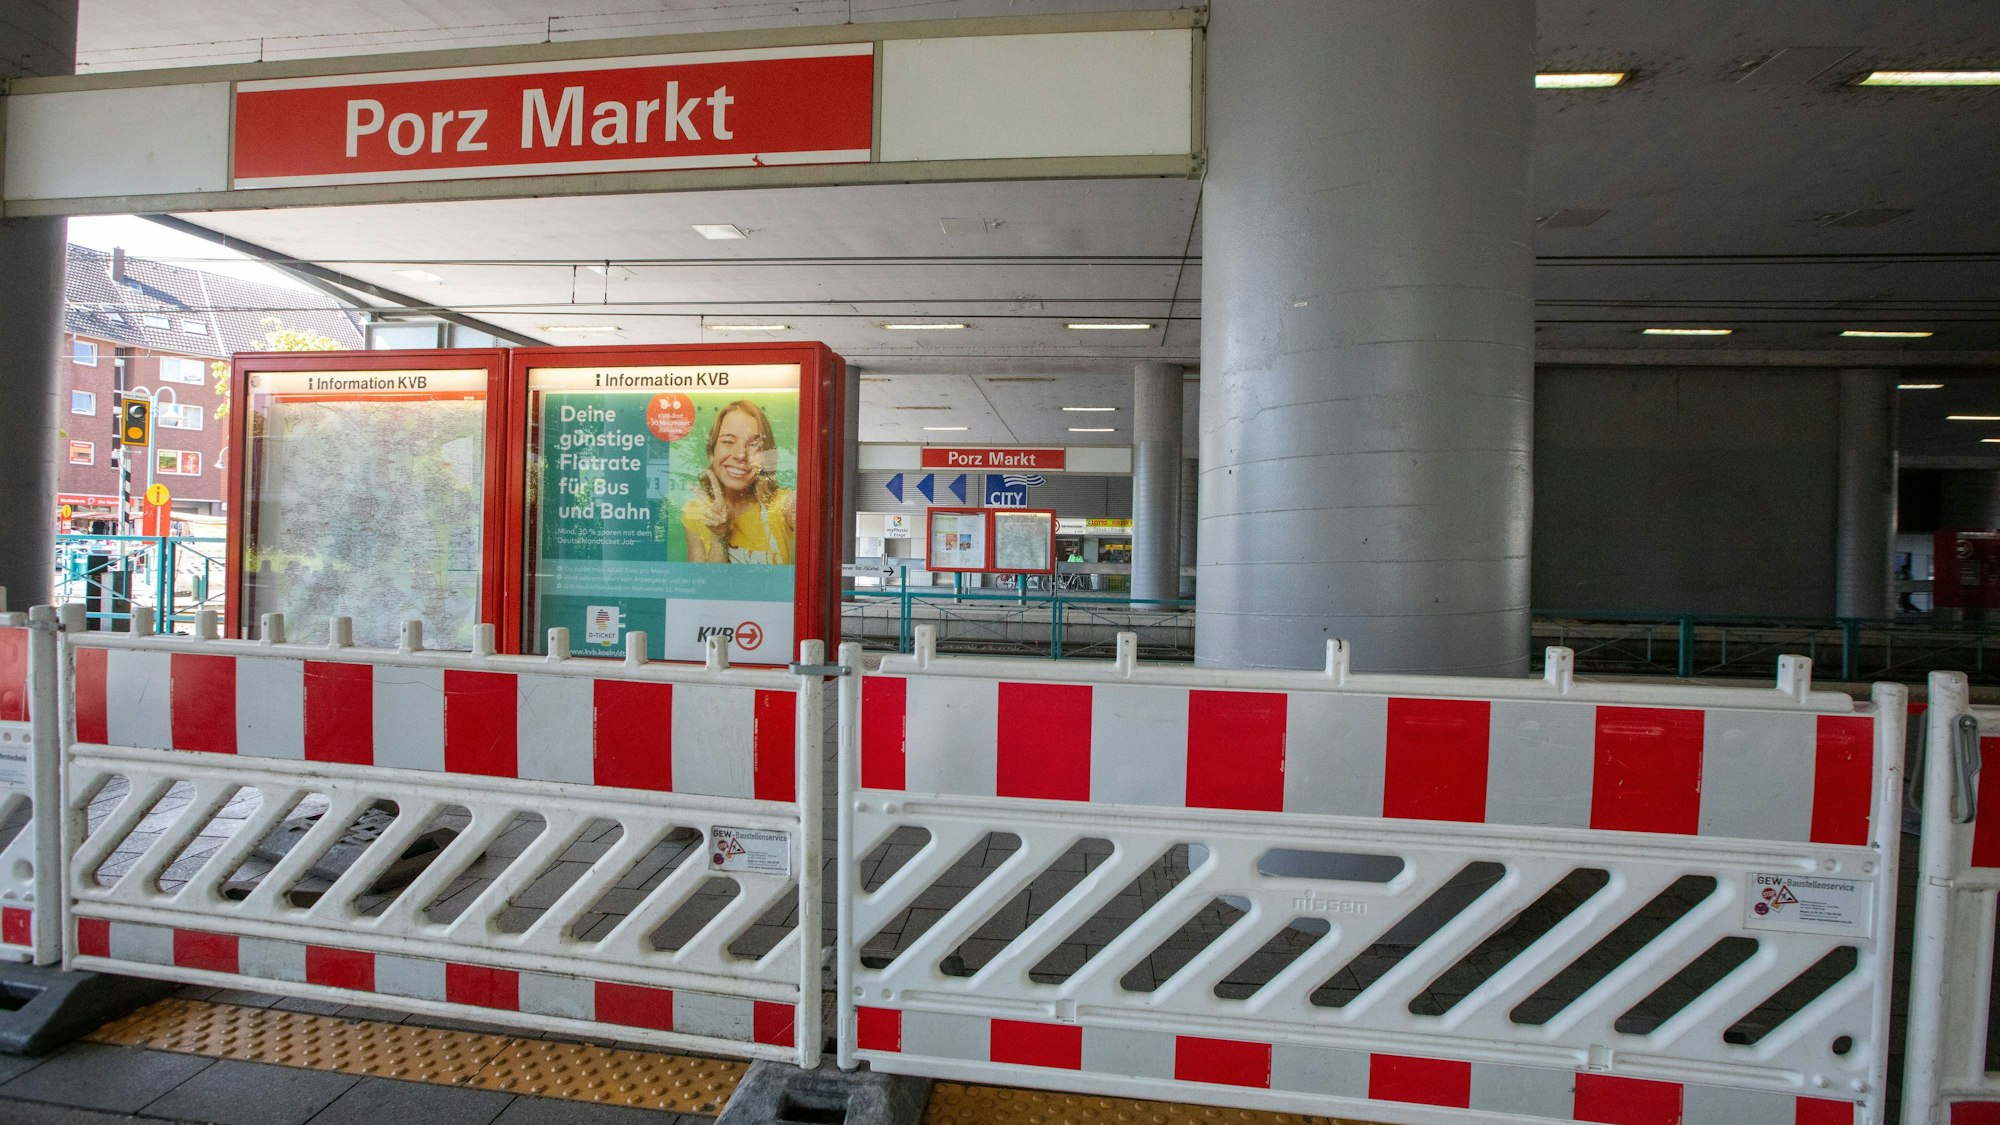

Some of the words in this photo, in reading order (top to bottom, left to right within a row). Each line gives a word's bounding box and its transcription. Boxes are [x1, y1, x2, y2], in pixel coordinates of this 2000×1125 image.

[345, 98, 489, 158] Porz
[521, 80, 735, 149] Markt
[317, 377, 395, 390] Information
[398, 376, 427, 389] KVB
[605, 373, 693, 387] Information
[696, 372, 729, 386] KVB
[560, 405, 617, 422] Deine
[559, 429, 646, 451] günstige
[559, 453, 641, 471] Flatrate
[948, 451, 983, 465] Porz
[988, 451, 1036, 466] Markt
[558, 477, 587, 495] für
[593, 478, 630, 495] Bus
[990, 491, 1024, 505] CITY
[558, 502, 595, 519] und
[600, 502, 651, 520] Bahn
[579, 528, 588, 536] 30
[588, 528, 597, 536] %
[597, 530, 621, 538] sparen
[1293, 889, 1368, 915] nissen
